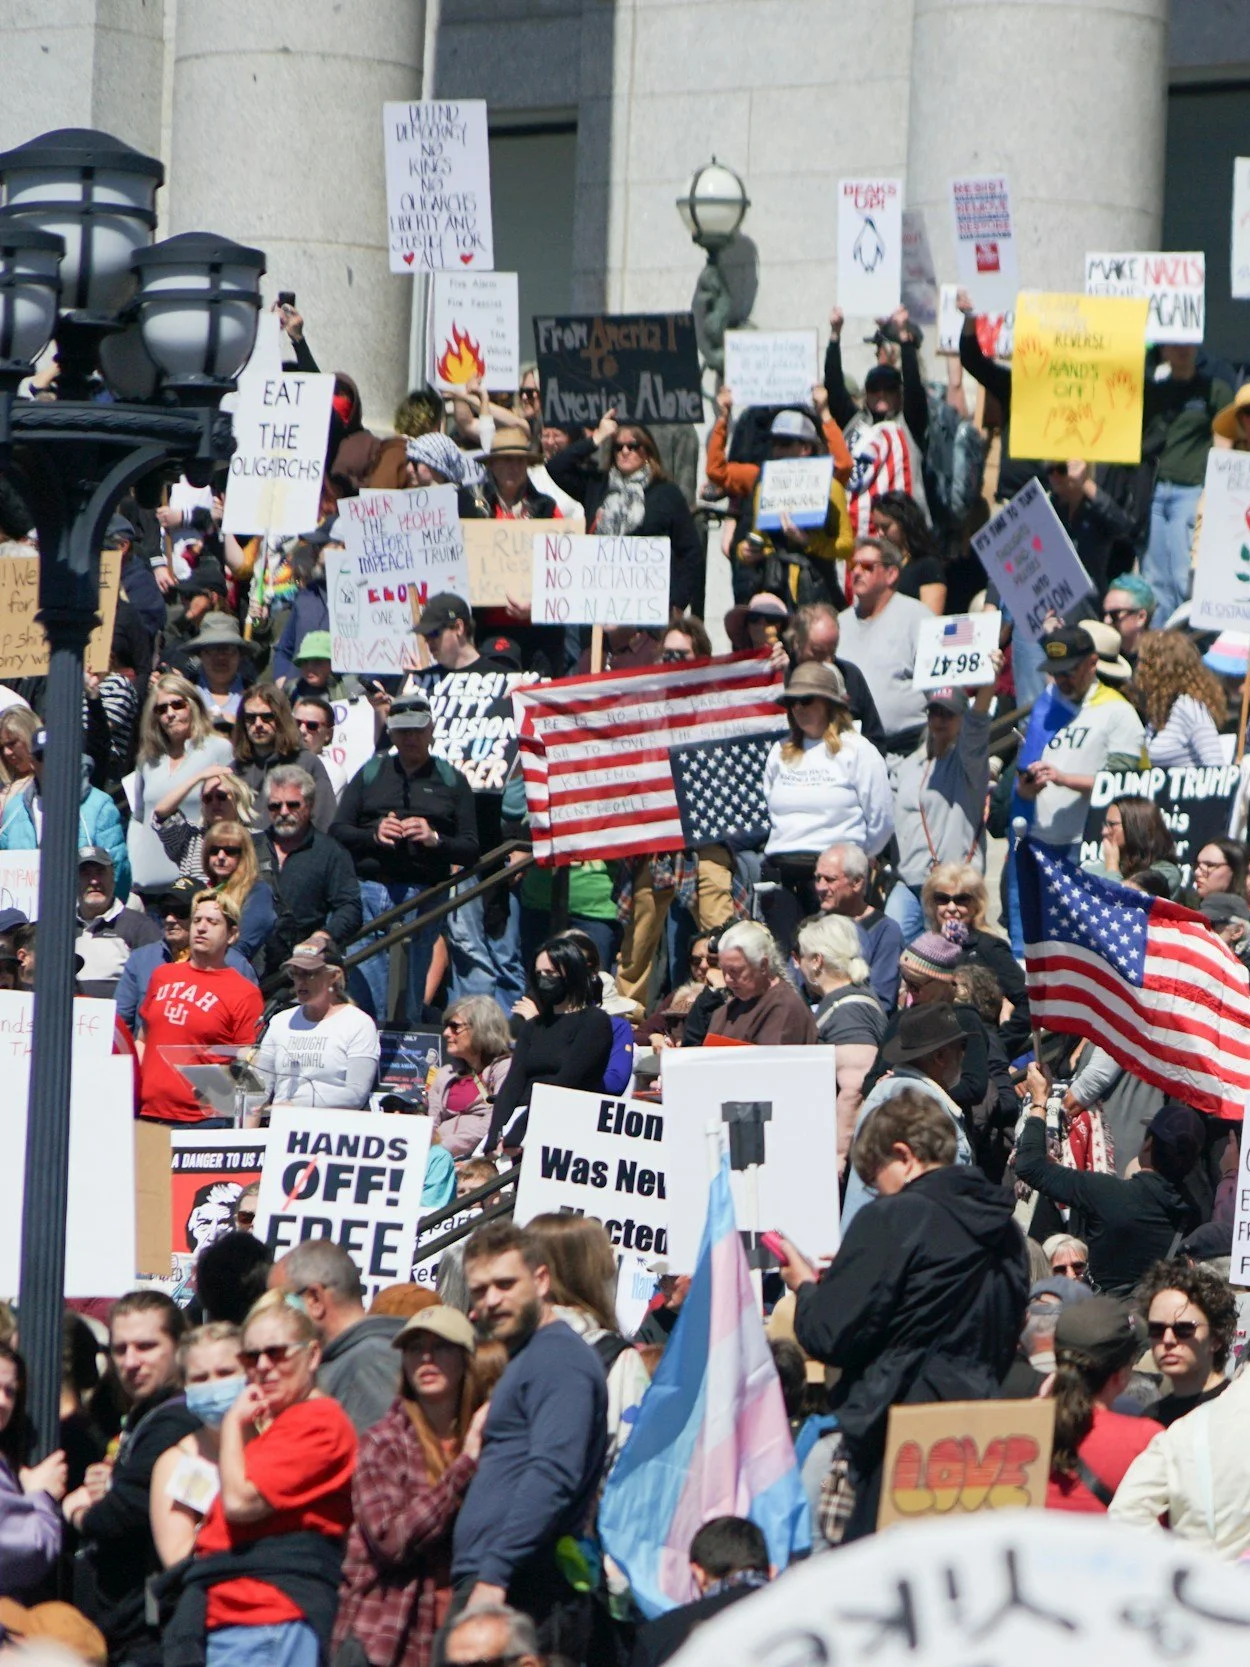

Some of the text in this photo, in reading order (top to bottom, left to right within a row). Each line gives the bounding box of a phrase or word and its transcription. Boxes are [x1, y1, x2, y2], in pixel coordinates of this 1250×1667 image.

[421, 143, 443, 157] NO
[409, 157, 452, 177] KINGS
[421, 177, 444, 193] NO
[853, 194, 886, 211] UP!
[1088, 258, 1205, 287] MAKE NAZIS
[1150, 293, 1202, 329] AGAIN
[537, 316, 590, 352] From
[263, 380, 305, 406] EAT
[259, 423, 300, 450] THE
[231, 456, 321, 481] OLIGARCHS
[348, 489, 429, 522] POWER TO
[362, 507, 447, 536] THE PEOPLE
[363, 524, 458, 555] DEPORT MUSK
[545, 534, 572, 562] NO
[596, 535, 666, 564] KINGS
[358, 543, 464, 575] IMPEACH TRUMP
[13, 561, 38, 587] We
[545, 566, 667, 592] NO DICTATORS
[7, 589, 35, 614] for
[544, 596, 662, 624] NO NAZIS
[606, 710, 626, 725] NO
[470, 738, 509, 762] US
[582, 743, 601, 757] TO
[561, 768, 637, 789] KILLING
[1091, 764, 1240, 807] DUMP TRUMP
[156, 980, 219, 1013] UTAH
[287, 1036, 328, 1052] THOUGHT
[282, 1052, 325, 1069] CRIMINAL
[596, 1099, 663, 1143] Elon
[286, 1130, 409, 1162] HANDS
[171, 1152, 255, 1170] A DANGER TO US
[541, 1145, 608, 1189] Was
[281, 1159, 405, 1208] OFF!
[892, 1434, 1041, 1515] LOVE
